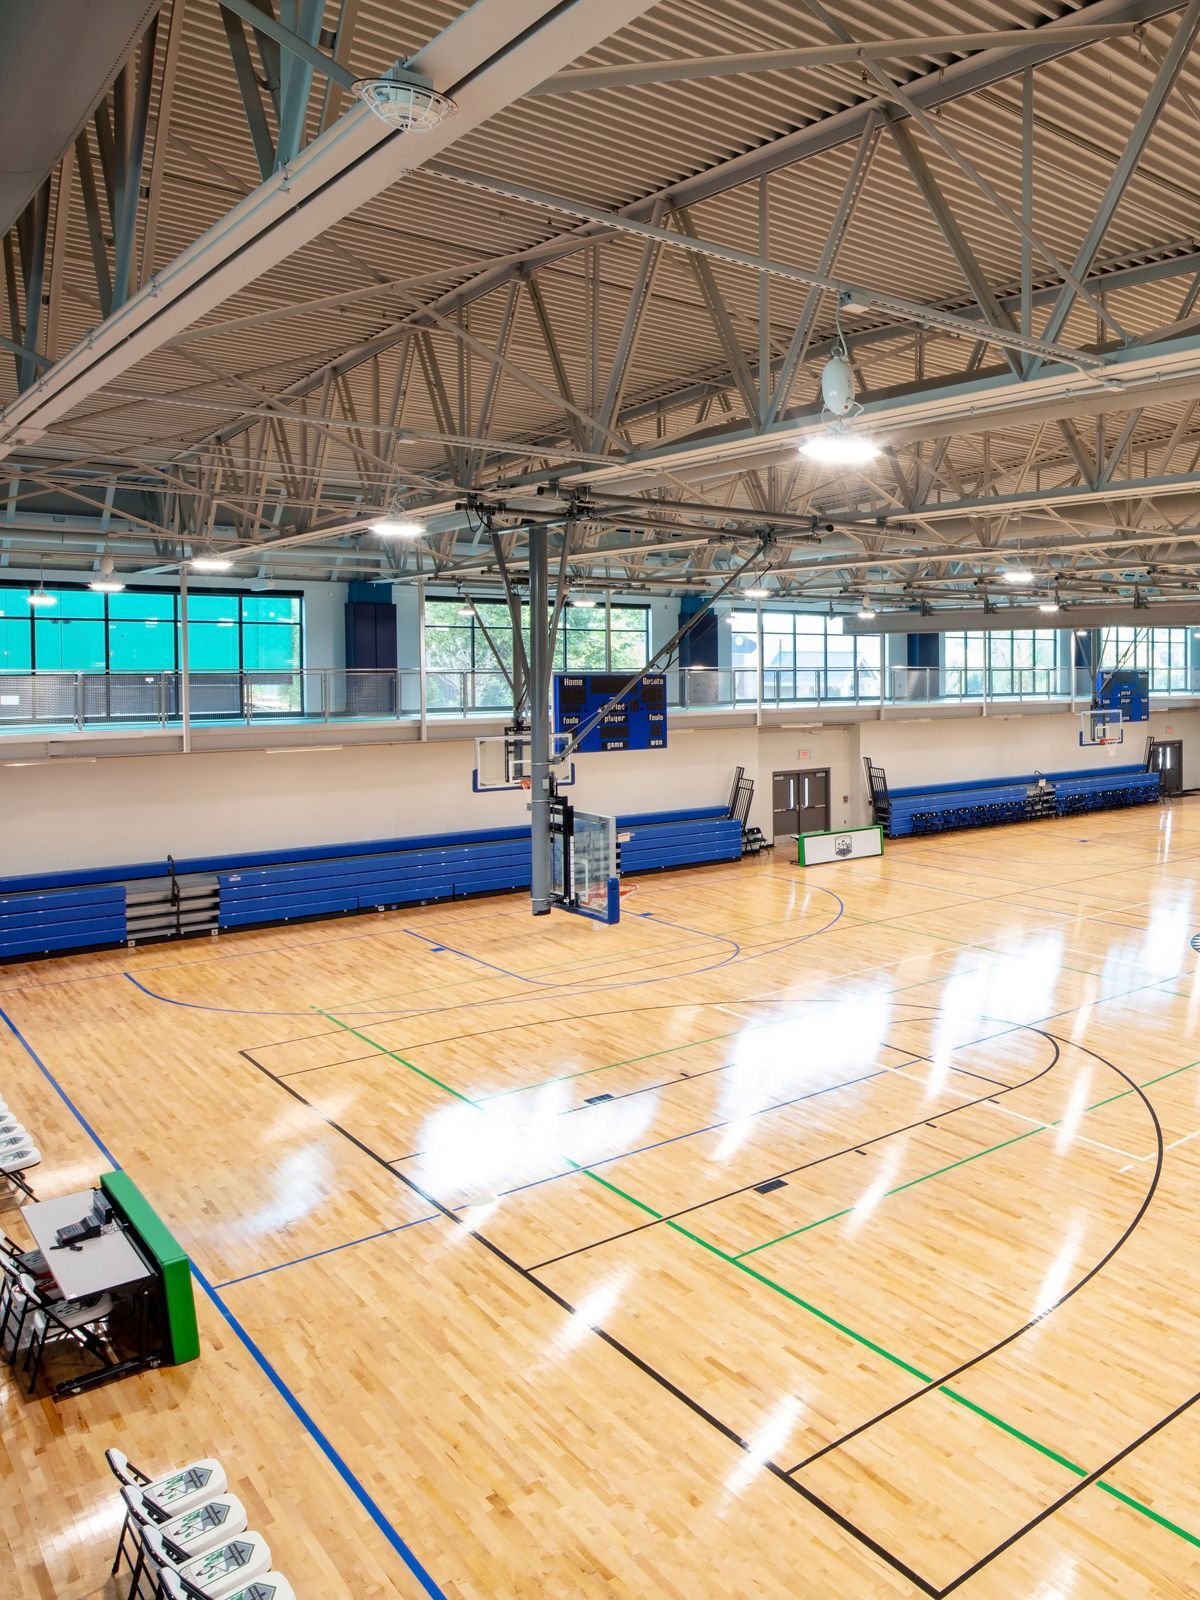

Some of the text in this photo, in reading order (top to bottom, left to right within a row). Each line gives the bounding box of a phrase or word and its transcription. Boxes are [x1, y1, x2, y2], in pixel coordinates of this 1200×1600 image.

[564, 678, 583, 686] Home
[563, 716, 579, 724] fouls
[604, 714, 625, 723] player
[607, 741, 623, 749] game
